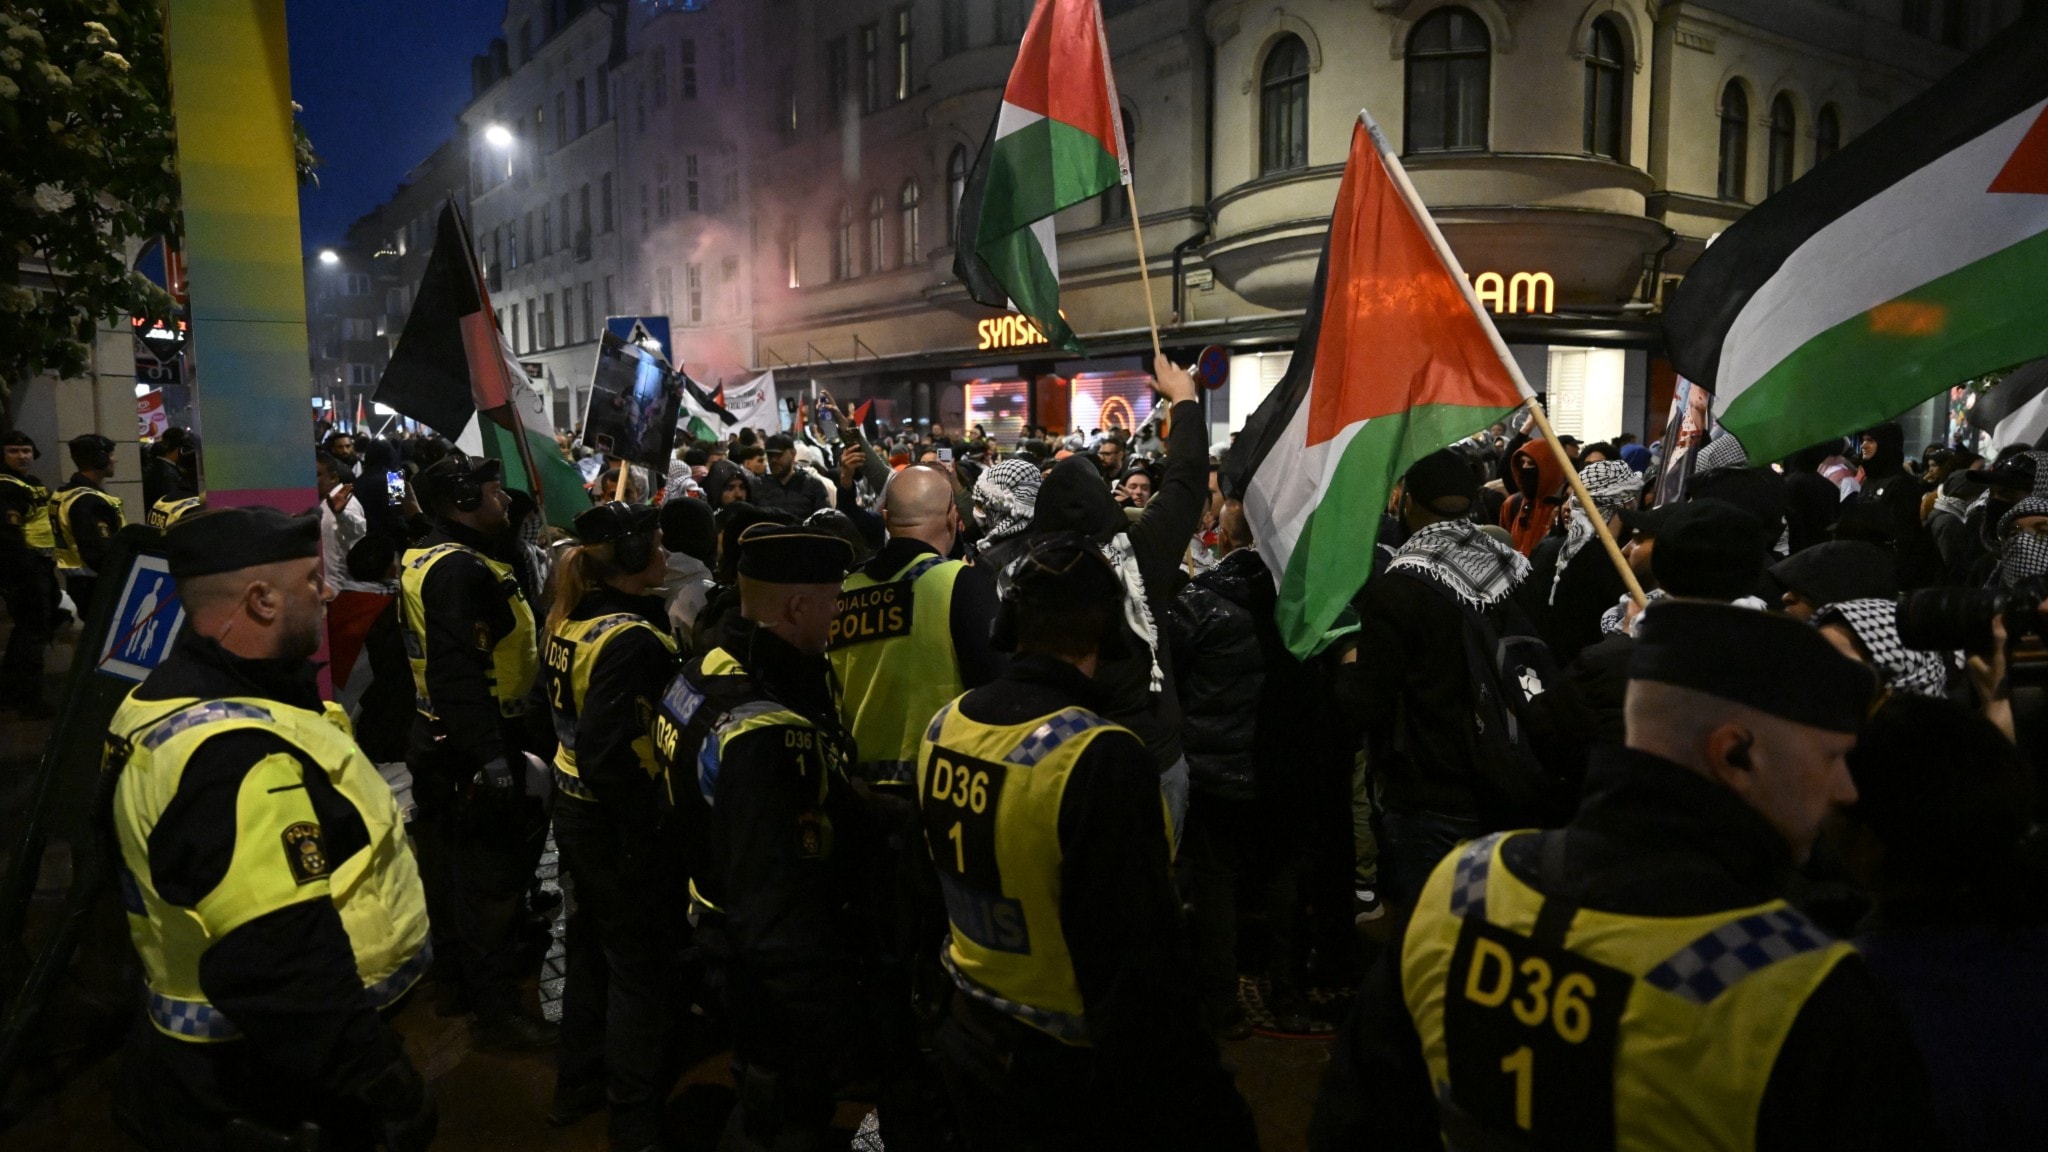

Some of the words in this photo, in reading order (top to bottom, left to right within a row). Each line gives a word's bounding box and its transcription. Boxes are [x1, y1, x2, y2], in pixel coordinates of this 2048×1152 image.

[978, 312, 1062, 350] SYNSA
[837, 588, 896, 612] DIALOG
[829, 606, 904, 645] POLIS
[548, 641, 570, 672] D36
[553, 676, 563, 710] 2
[657, 714, 679, 762] D36
[785, 729, 812, 750] D36
[796, 753, 806, 776] 1
[932, 756, 990, 815] D36
[947, 820, 965, 874] 1
[1464, 936, 1597, 1045] D36
[1500, 1045, 1534, 1132] 1
